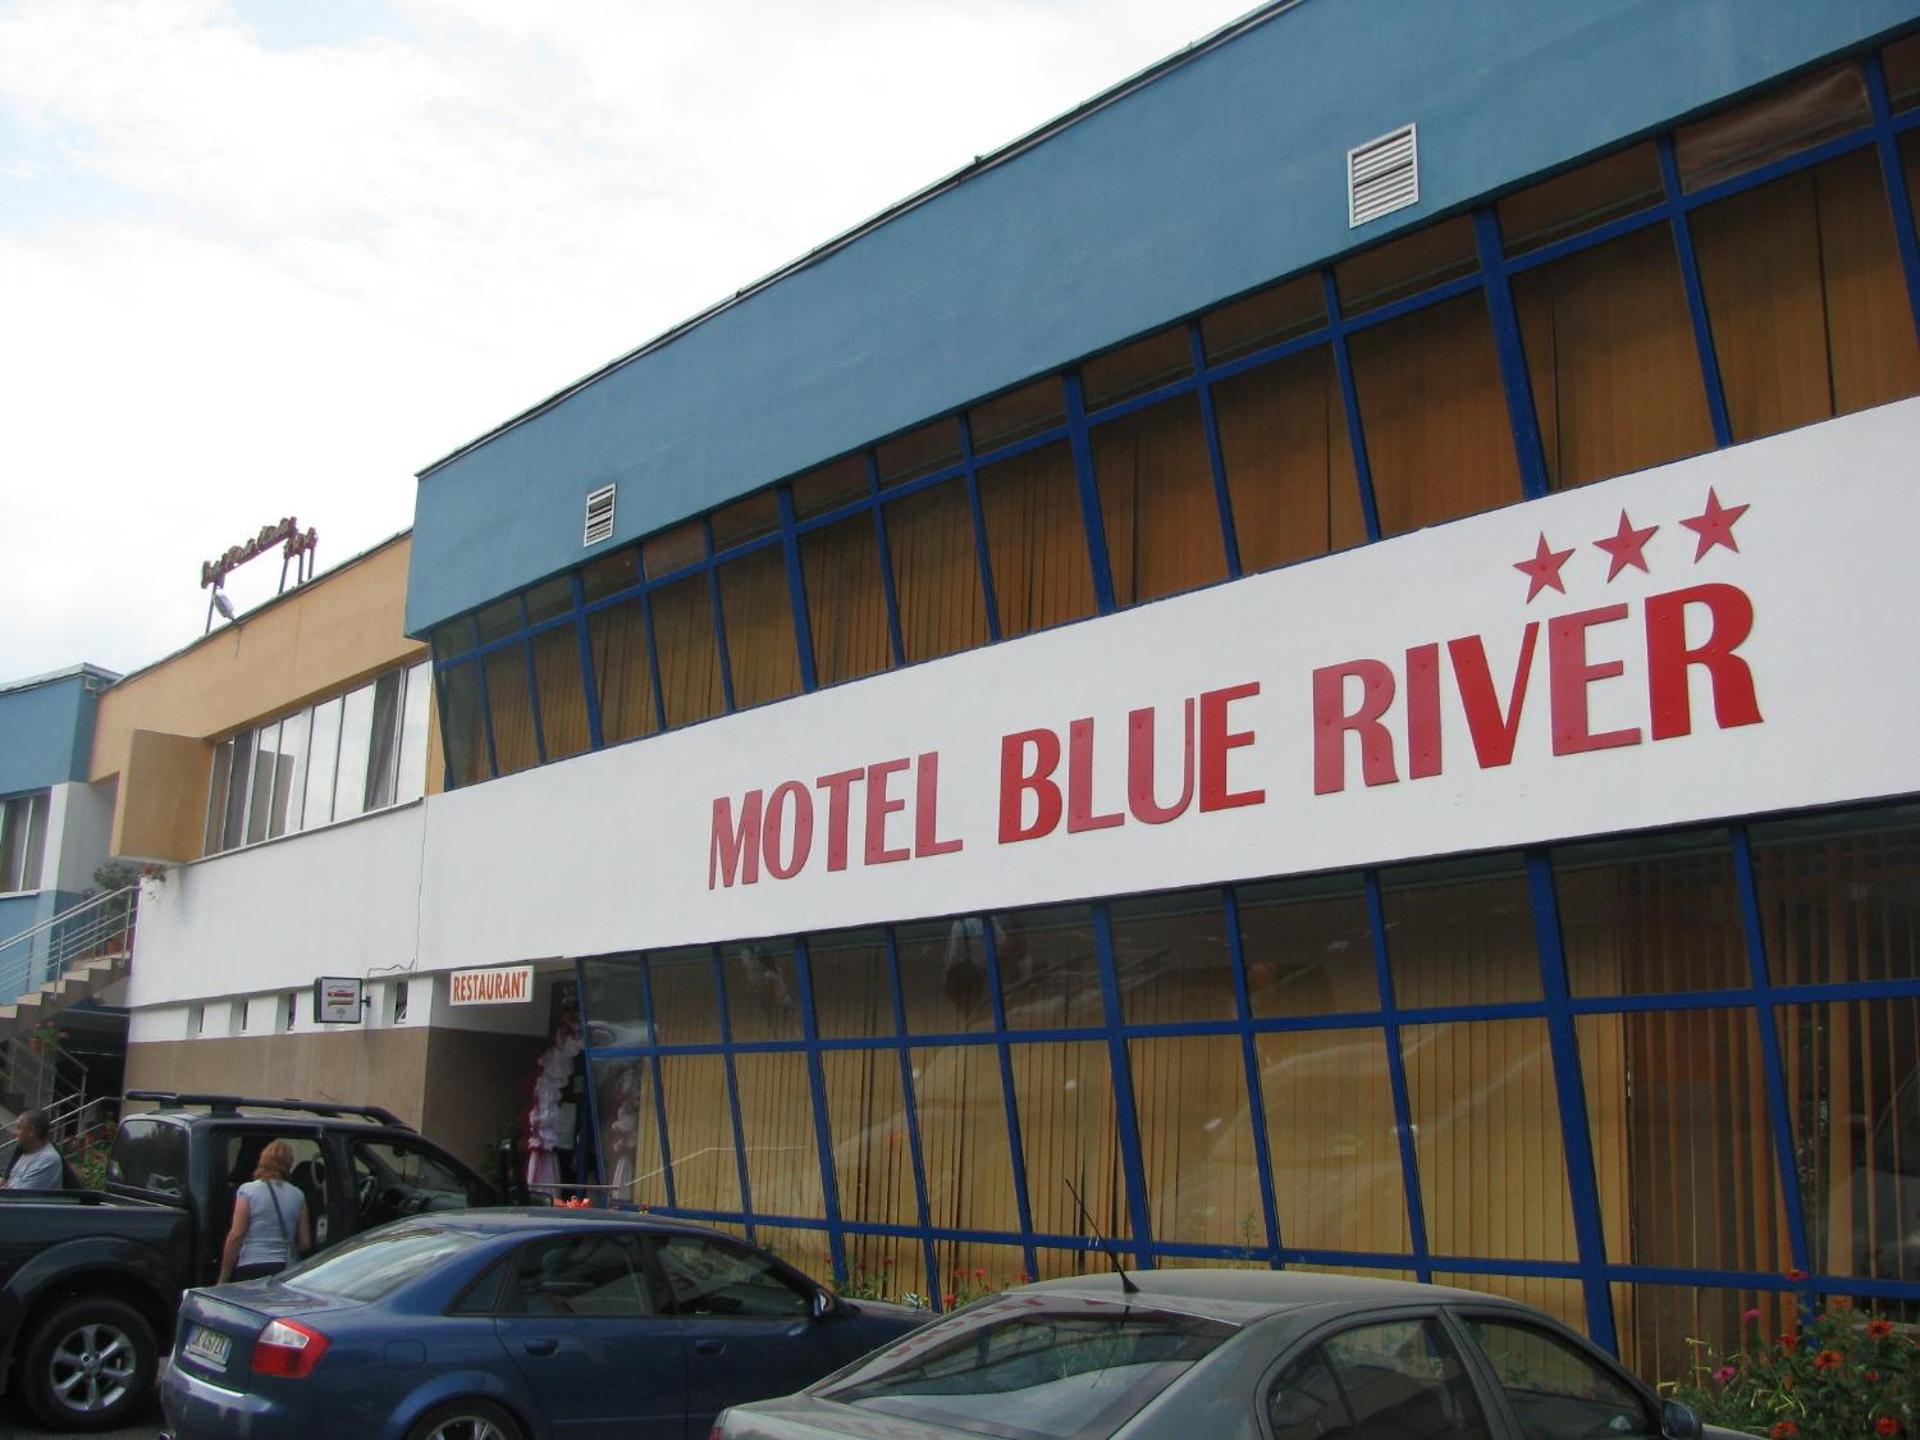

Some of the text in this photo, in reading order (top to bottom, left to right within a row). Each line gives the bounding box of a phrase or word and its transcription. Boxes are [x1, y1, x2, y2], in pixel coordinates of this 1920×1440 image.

[711, 582, 1763, 890] MOTEL BLUE RIVER
[453, 970, 529, 1002] RESTAURANT
